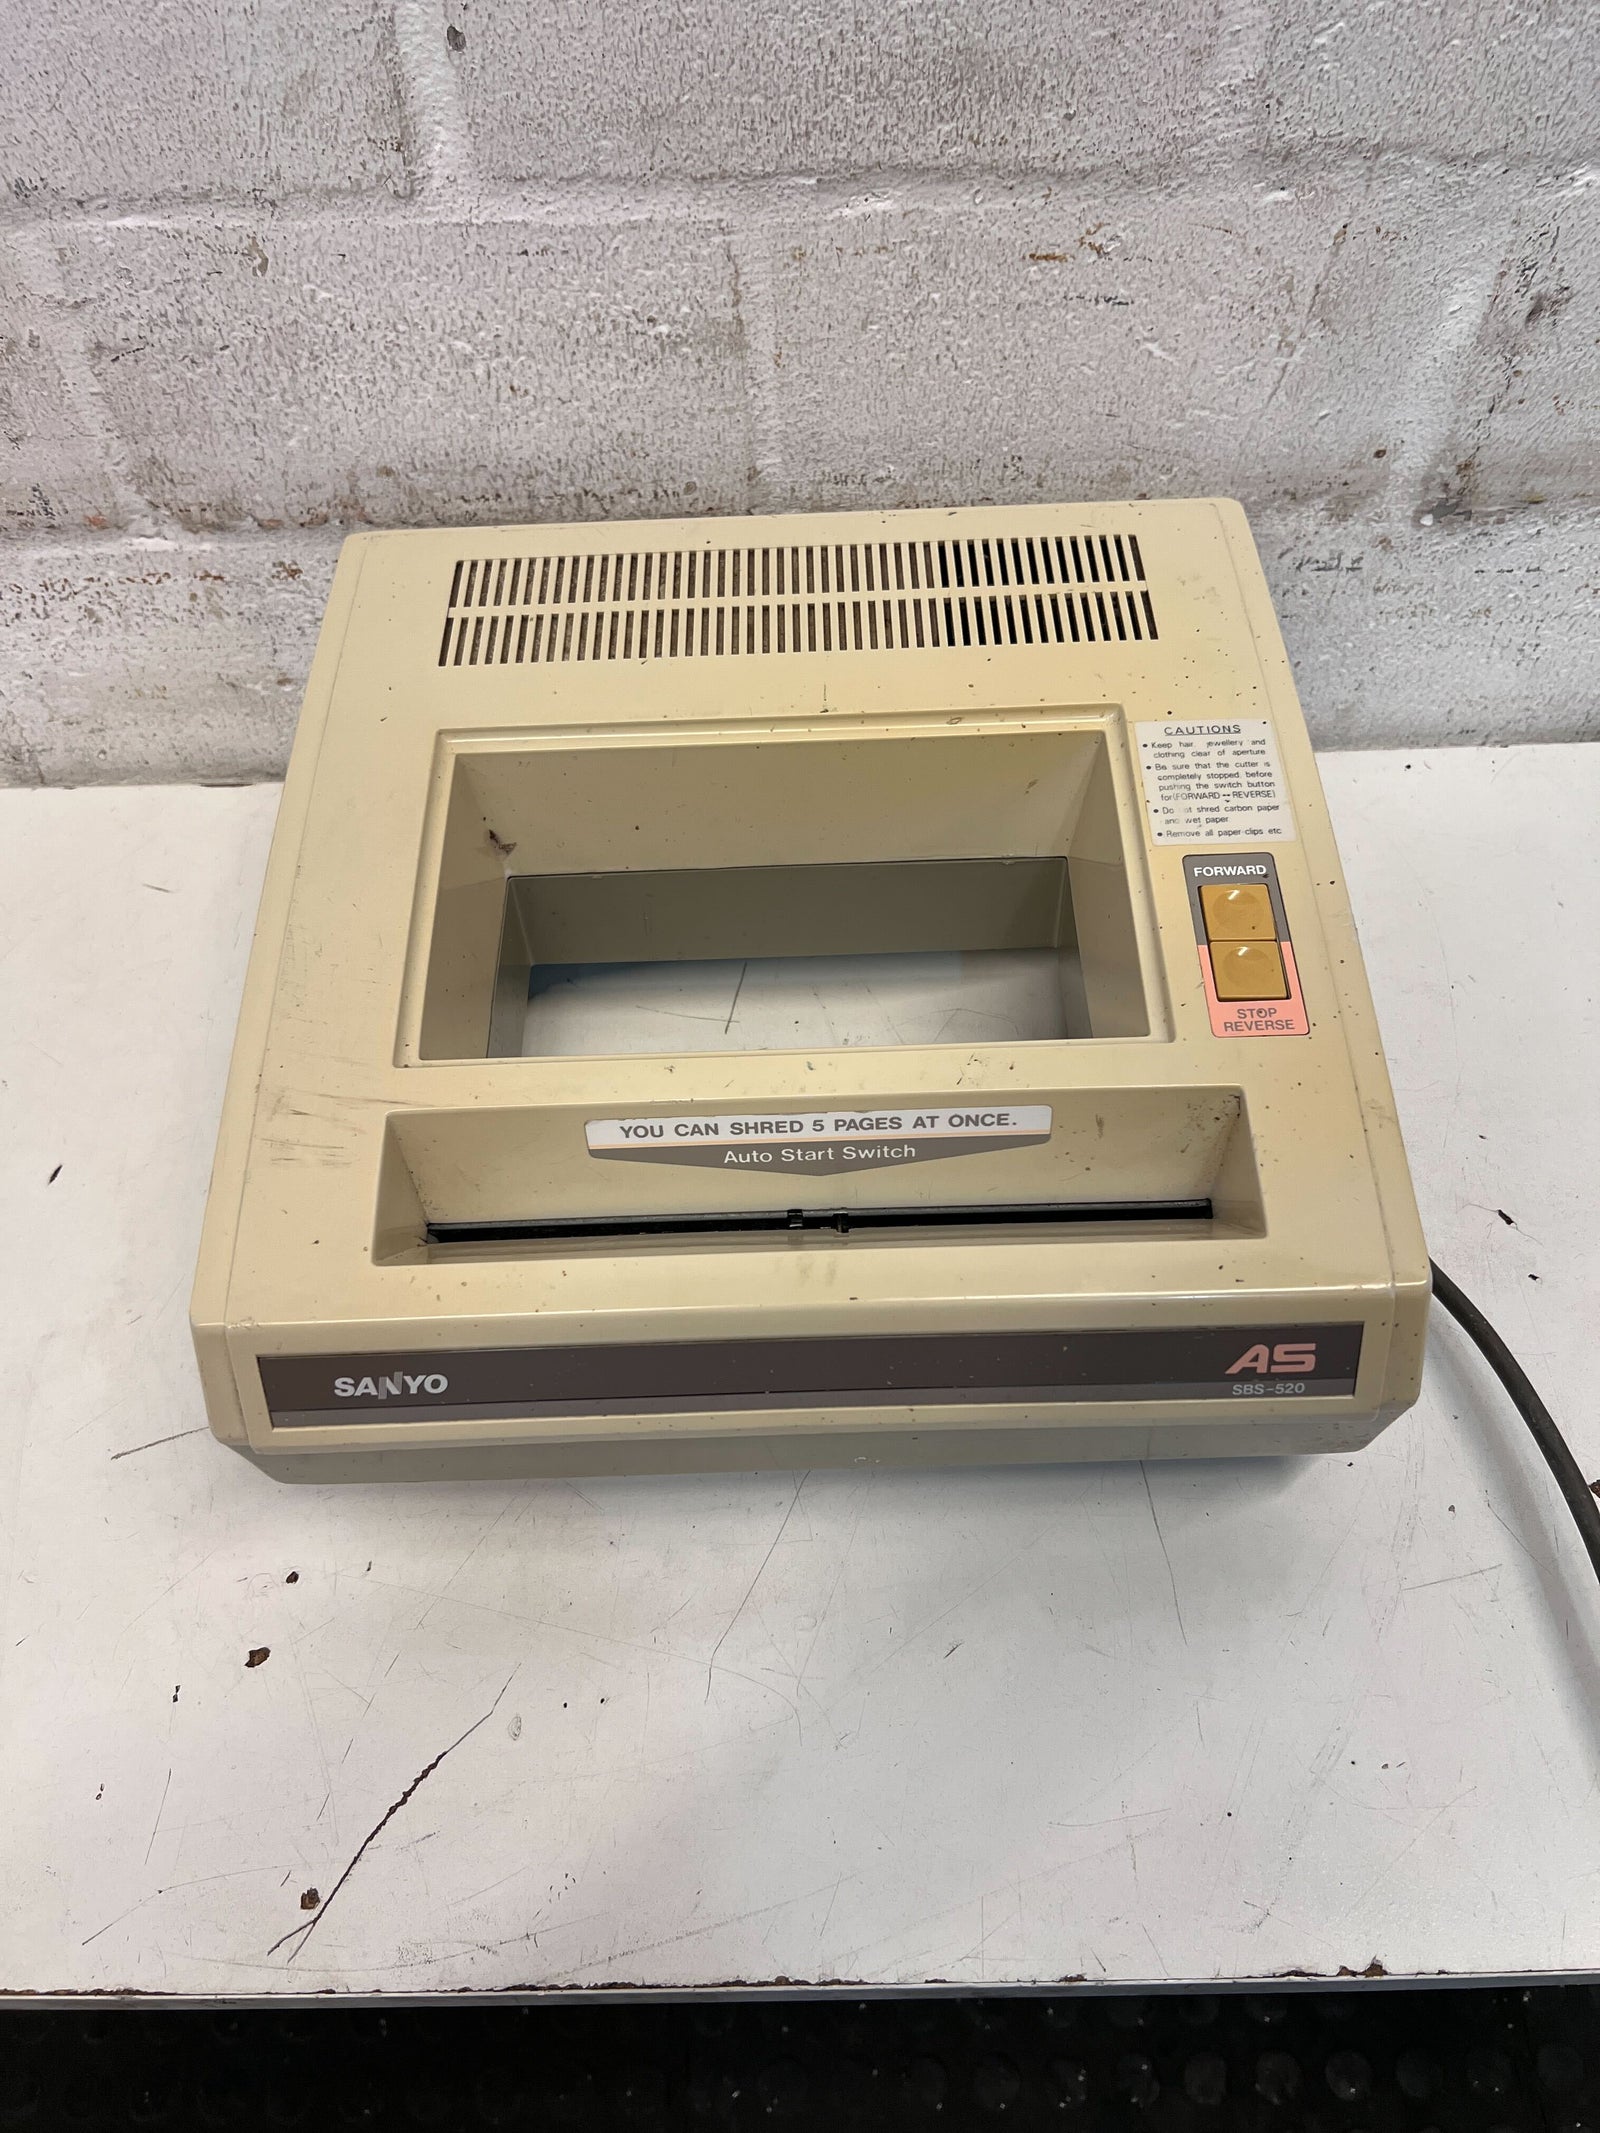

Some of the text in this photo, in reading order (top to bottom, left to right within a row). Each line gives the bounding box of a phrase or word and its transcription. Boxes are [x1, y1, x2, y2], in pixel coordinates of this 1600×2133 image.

[1164, 725, 1241, 735] CAUTIONS
[1207, 739, 1243, 748] jewellery
[1154, 750, 1185, 759] clothing
[1235, 760, 1259, 768] cutter
[1158, 772, 1202, 781] completely
[1207, 771, 1239, 780] stopped
[1159, 783, 1191, 791] pushing
[1248, 780, 1275, 788] button
[1224, 803, 1252, 811] carbon
[1205, 816, 1228, 824] paper
[1205, 828, 1213, 836] all
[1218, 829, 1241, 837] paper
[1194, 865, 1267, 877] FORWARD
[1237, 1008, 1277, 1019] STOP
[1224, 1019, 1295, 1032] REVERSE
[619, 1113, 1018, 1139] YOU CAN SHRED 5 PAGES AT ONCE.
[724, 1144, 916, 1164] Auto Start Switch
[1225, 1343, 1316, 1374] AS
[334, 1371, 448, 1399] SANYO
[1232, 1383, 1305, 1395] SBS-520
